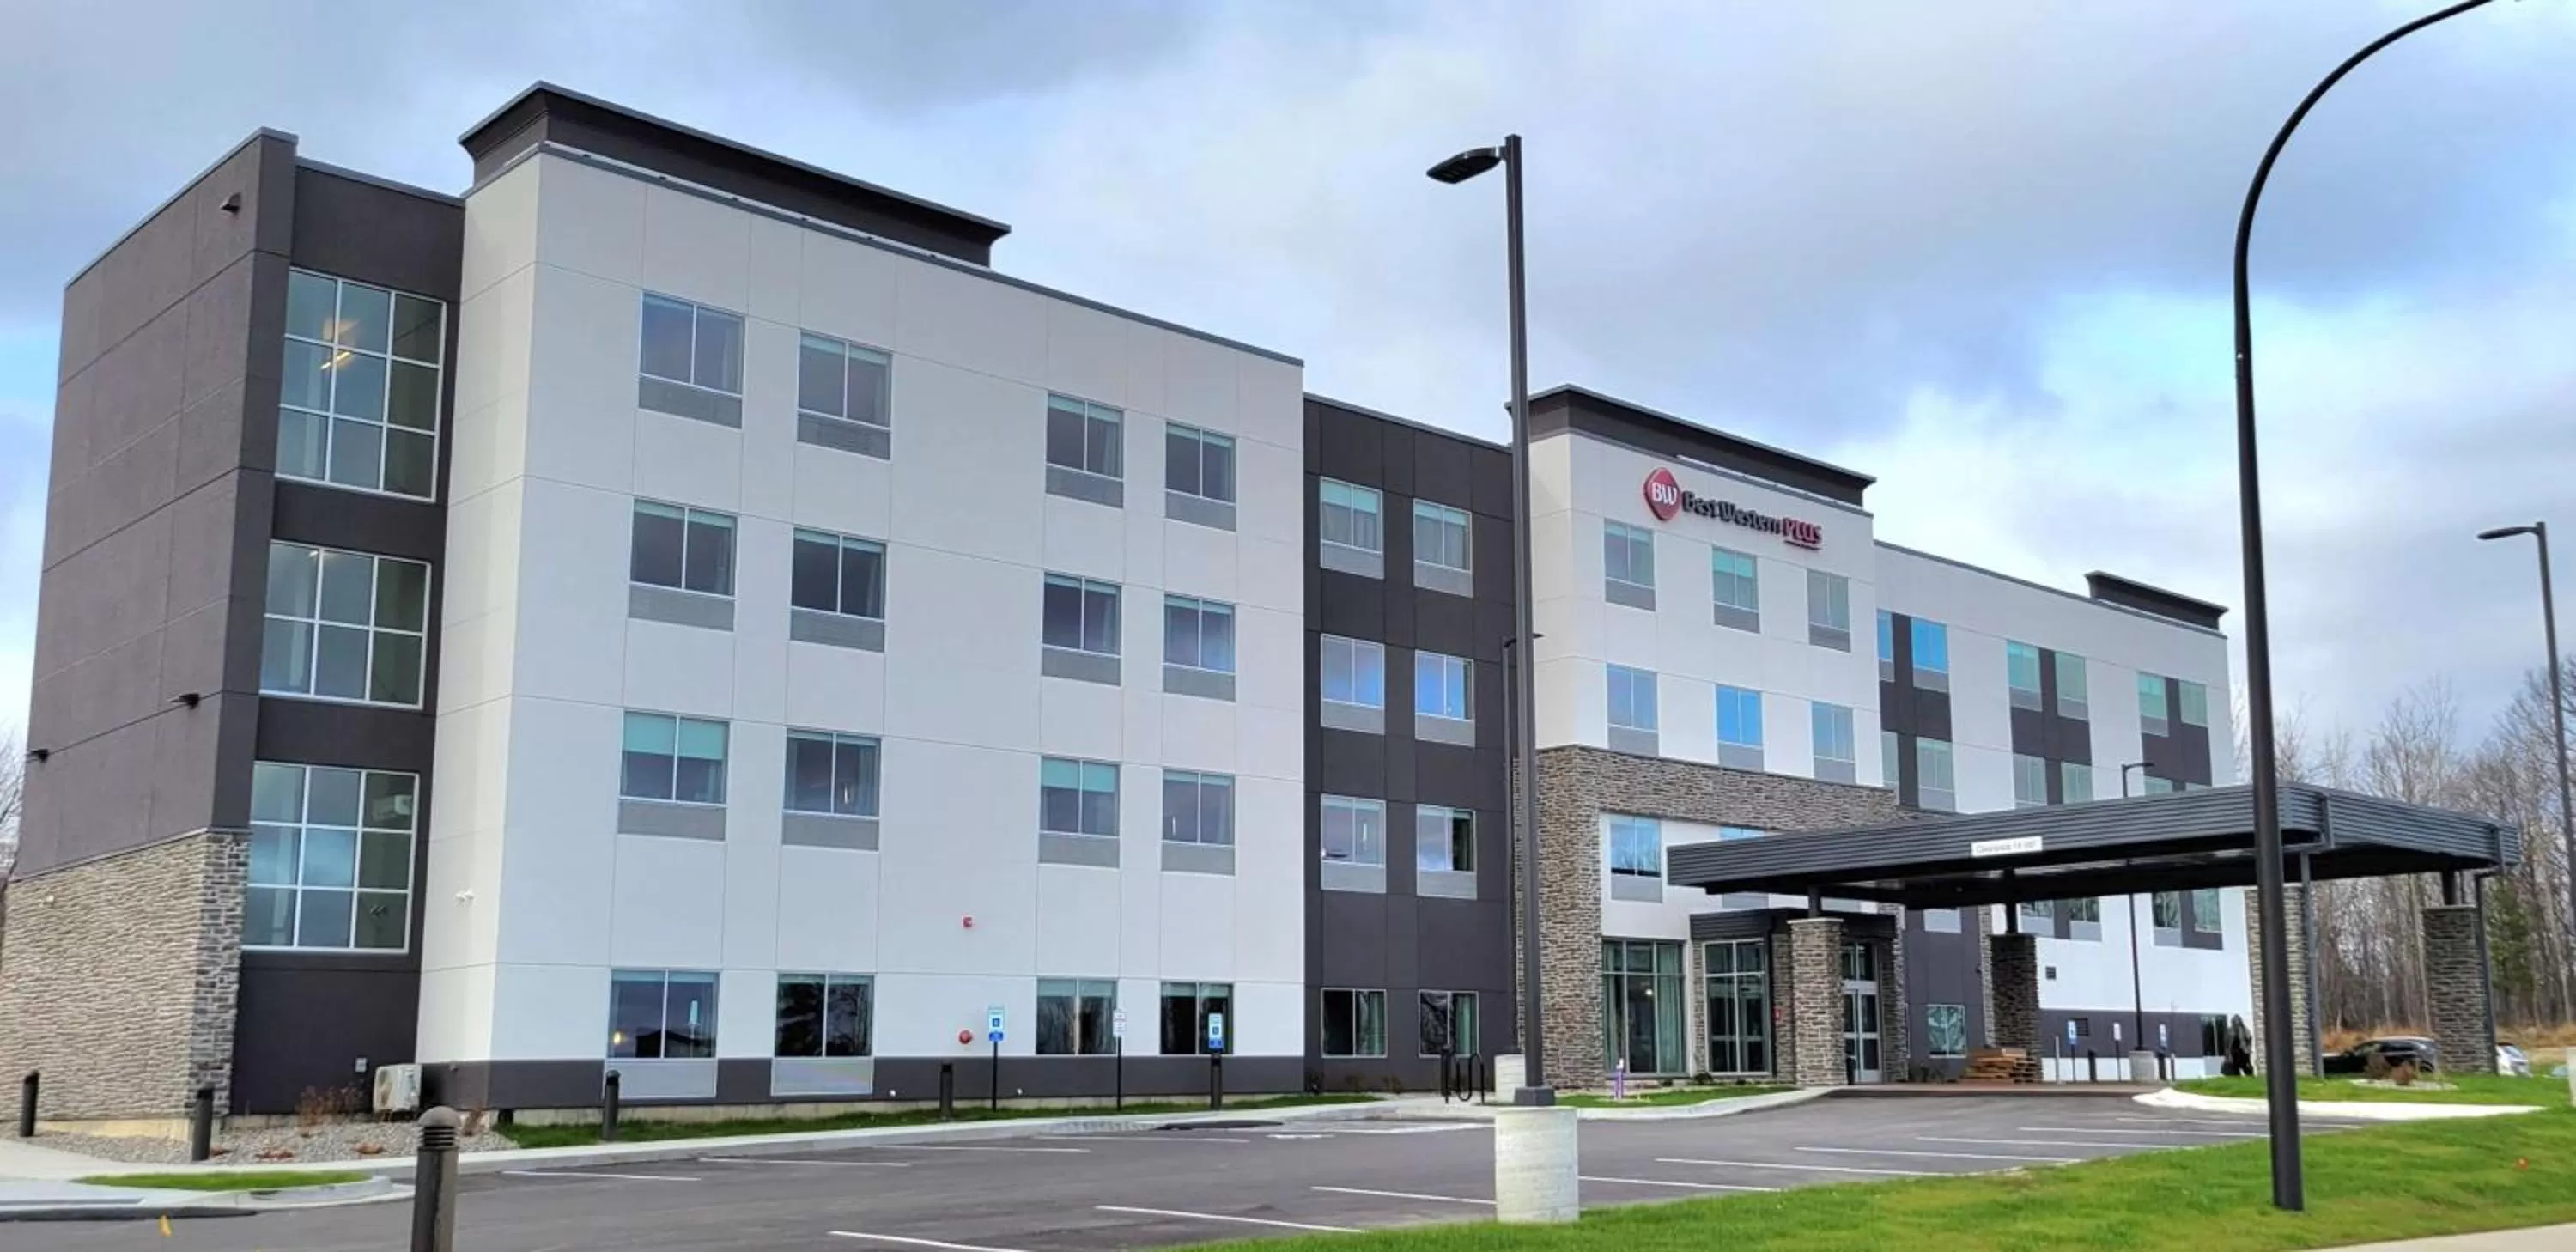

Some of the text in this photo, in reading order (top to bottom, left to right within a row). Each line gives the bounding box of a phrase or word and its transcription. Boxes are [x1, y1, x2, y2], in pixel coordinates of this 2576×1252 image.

[1651, 482, 1677, 505] BW
[1681, 490, 1822, 544] Best Western PLUS
